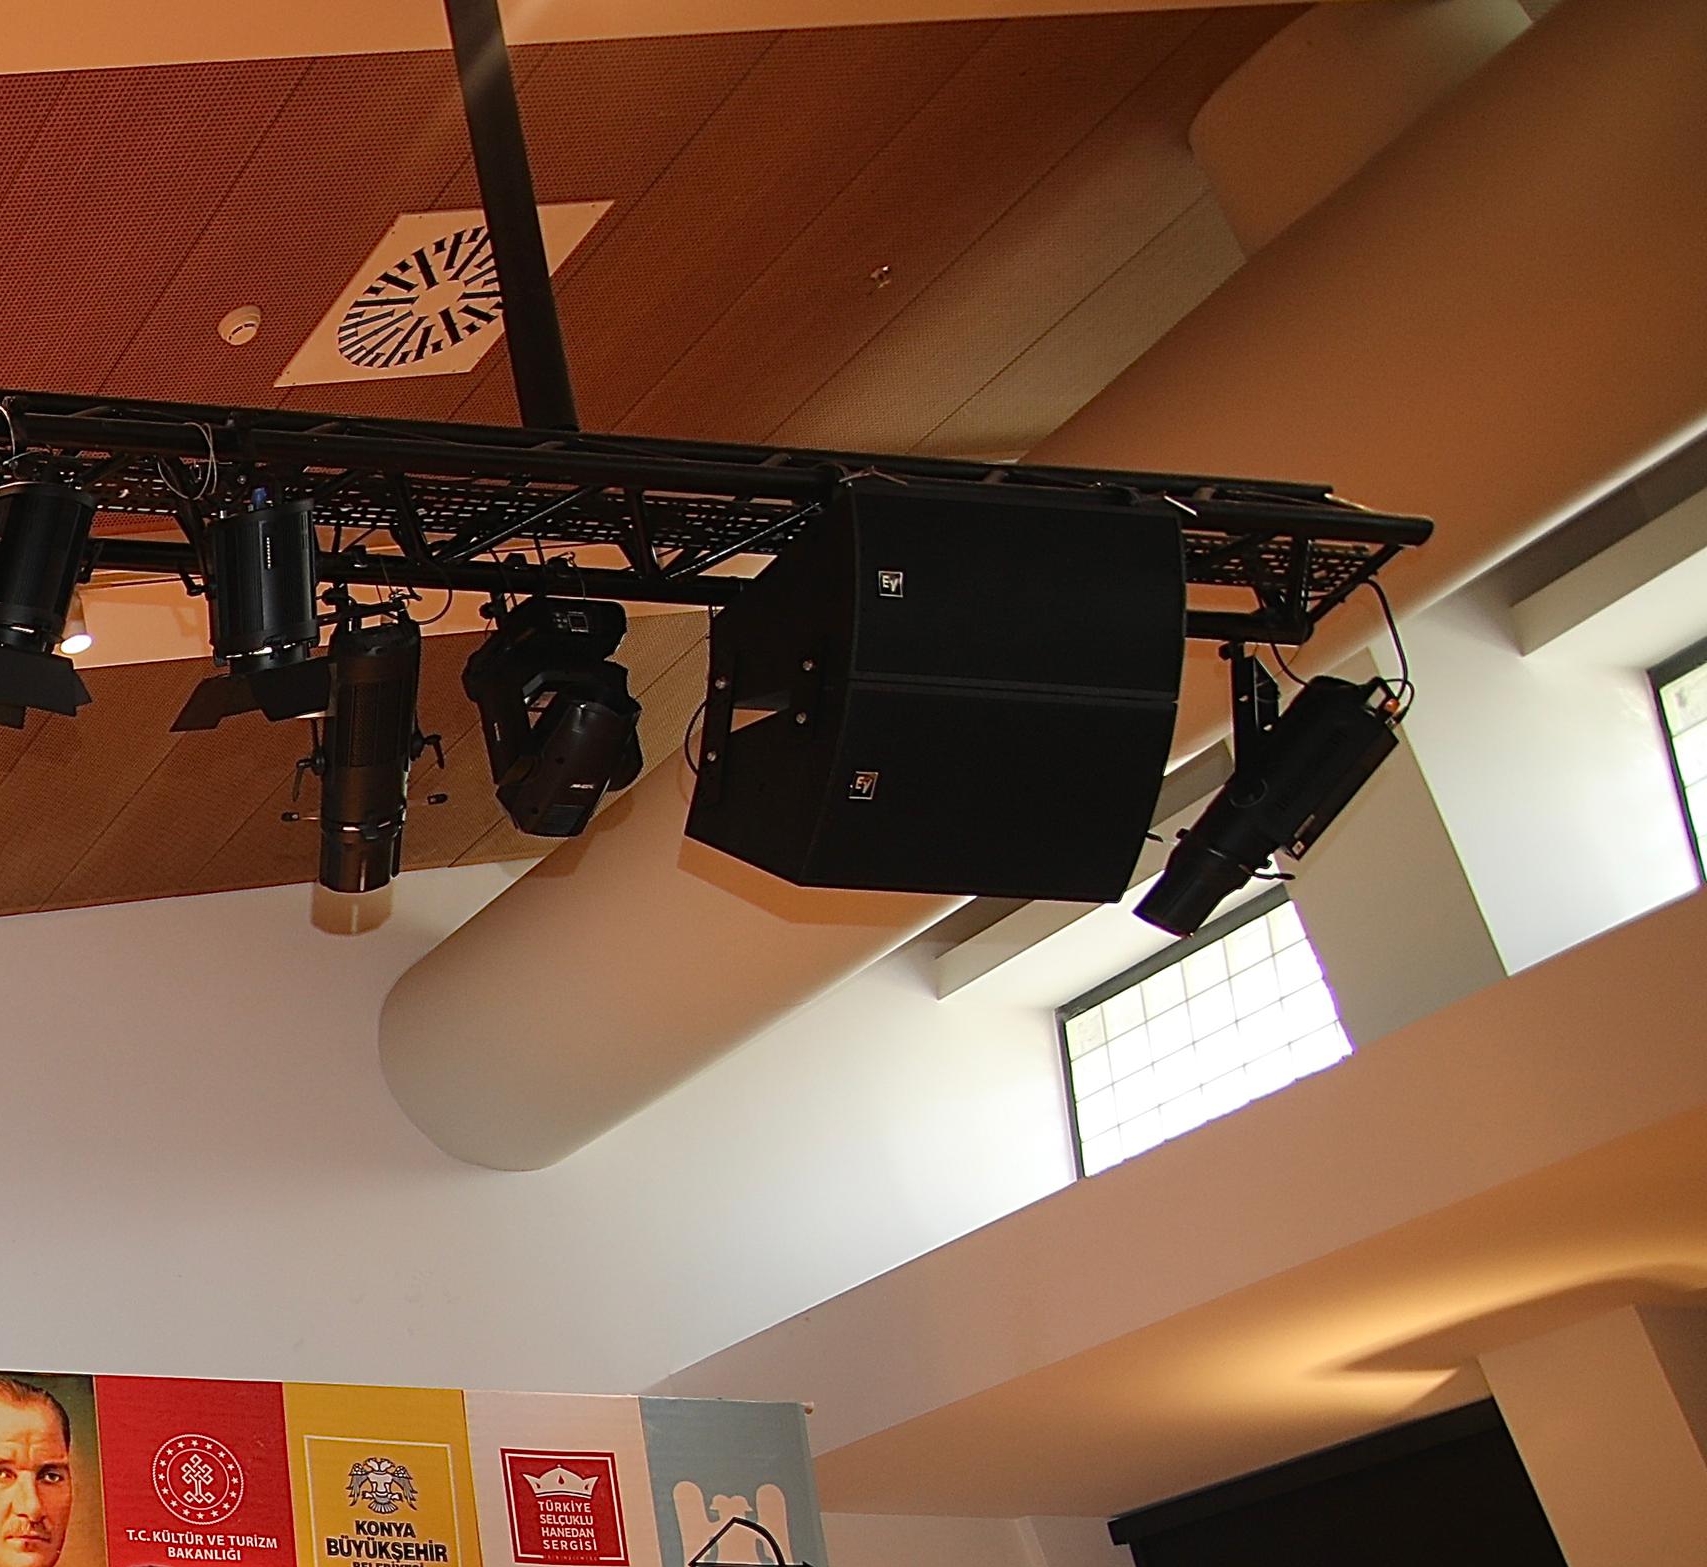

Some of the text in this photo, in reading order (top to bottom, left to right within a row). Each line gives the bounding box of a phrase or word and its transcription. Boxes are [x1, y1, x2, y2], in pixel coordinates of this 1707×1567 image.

[537, 1500, 592, 1513] TÜRKİYE
[539, 1514, 594, 1526] SELÇUKLU
[355, 1520, 416, 1538] KONYA
[541, 1527, 595, 1538] HANEDAN
[126, 1529, 278, 1549] T.C. KÜLTÜR VE TURİZM
[543, 1538, 597, 1551] SERGİSİ
[168, 1547, 242, 1561] BAKANLIĞI
[326, 1535, 448, 1562] BÜYÜKŞEHİR
